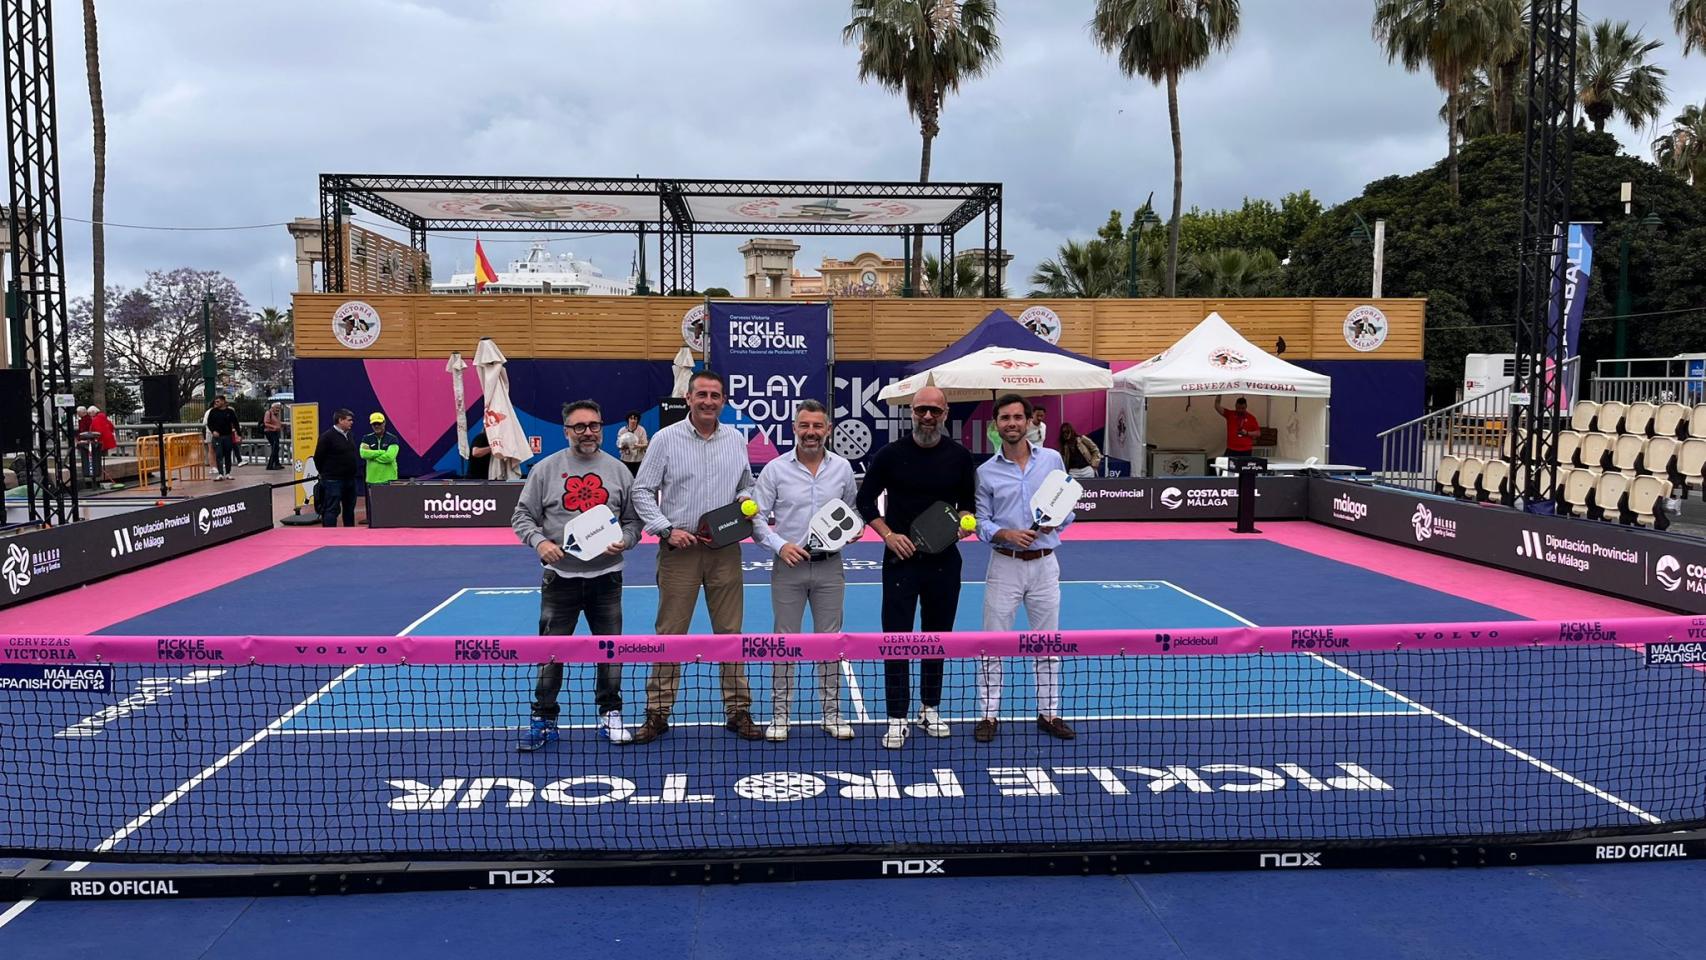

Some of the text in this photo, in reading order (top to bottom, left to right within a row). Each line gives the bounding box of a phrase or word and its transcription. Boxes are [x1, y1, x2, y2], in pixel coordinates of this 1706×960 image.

[729, 321, 785, 335] PICKLE
[729, 375, 808, 397] PLAY
[1181, 381, 1297, 392] CERVEZAS VICTORIA
[1100, 489, 1144, 498] Provincial
[1187, 488, 1239, 498] COSTA DEL
[424, 492, 496, 515] málaga
[1187, 497, 1228, 507] MÁLAGA
[133, 513, 190, 537] Diputación Provincial
[212, 515, 233, 529] MÁLAGA
[134, 535, 165, 551] de Málaga
[1545, 534, 1638, 564] Diputación Provincial
[1545, 552, 1590, 572] de Málaga
[1560, 622, 1601, 632] PICKLE
[883, 635, 941, 644] CERVEZAS
[1019, 634, 1062, 643] PICKLE
[1292, 629, 1333, 638] PICKLE
[9, 637, 71, 647] CERVEZAS
[158, 639, 204, 650] PICKLE
[455, 639, 500, 650] PICKLE
[742, 637, 785, 648] PICKLE
[1173, 636, 1218, 648] picklebull
[4, 648, 77, 660] VICTORIA
[618, 642, 665, 656] picklebull
[878, 645, 946, 656] VICTORIA
[44, 666, 104, 680] MÁLAGA
[52, 679, 88, 690] OPEN
[986, 762, 1394, 797] PICKLE
[385, 773, 715, 811] TOUR
[1596, 843, 1687, 859] RED OFICIAL
[70, 880, 179, 896] RED OFICIAL
